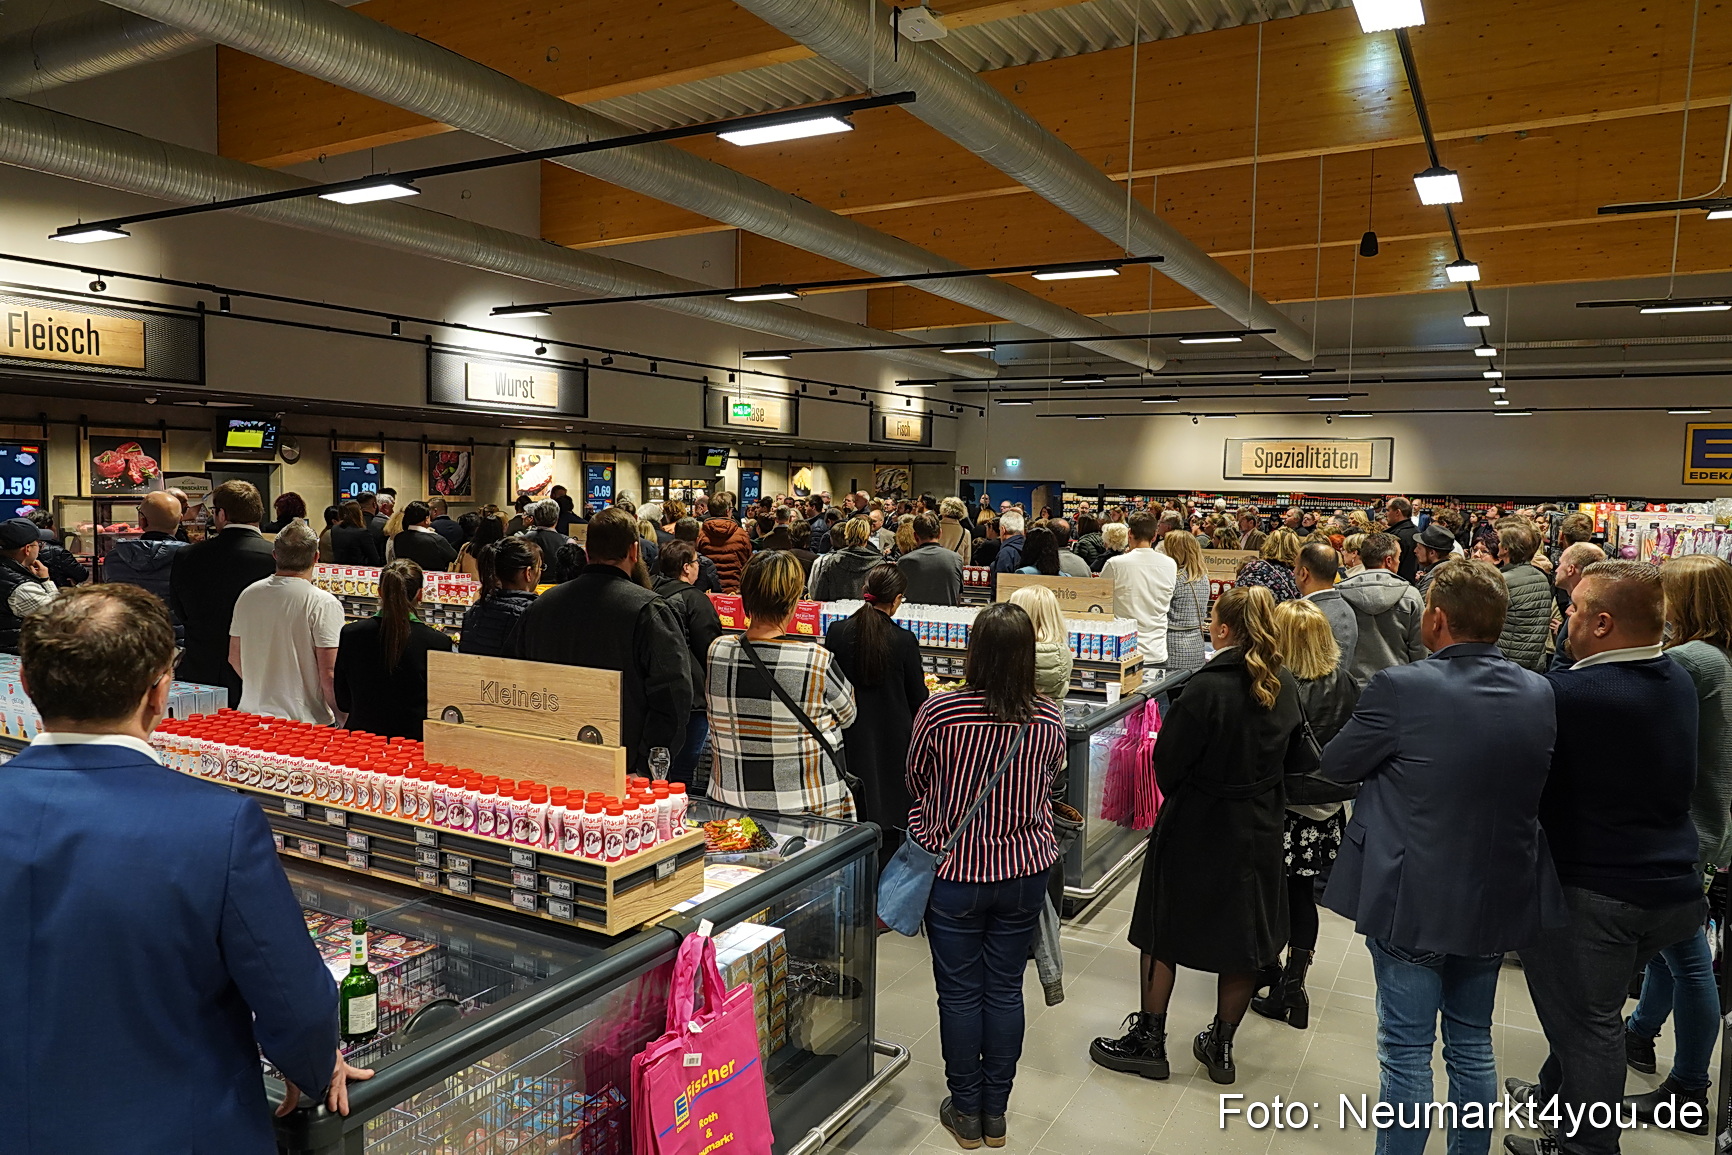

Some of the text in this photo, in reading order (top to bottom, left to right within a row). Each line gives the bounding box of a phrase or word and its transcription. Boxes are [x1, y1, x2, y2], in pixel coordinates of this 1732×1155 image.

[7, 310, 100, 357] Fleisch
[494, 371, 535, 399] Wurst
[746, 403, 765, 423] äse
[896, 420, 911, 437] Fisch
[1253, 445, 1359, 474] Spezialitäten
[594, 485, 611, 497] 0.69
[744, 487, 759, 498] 2.49
[480, 679, 560, 712] Kleineis
[686, 1058, 736, 1103] Fischer
[698, 1111, 719, 1130] Roth
[698, 1132, 734, 1155] umarkt
[705, 1128, 713, 1139] &
